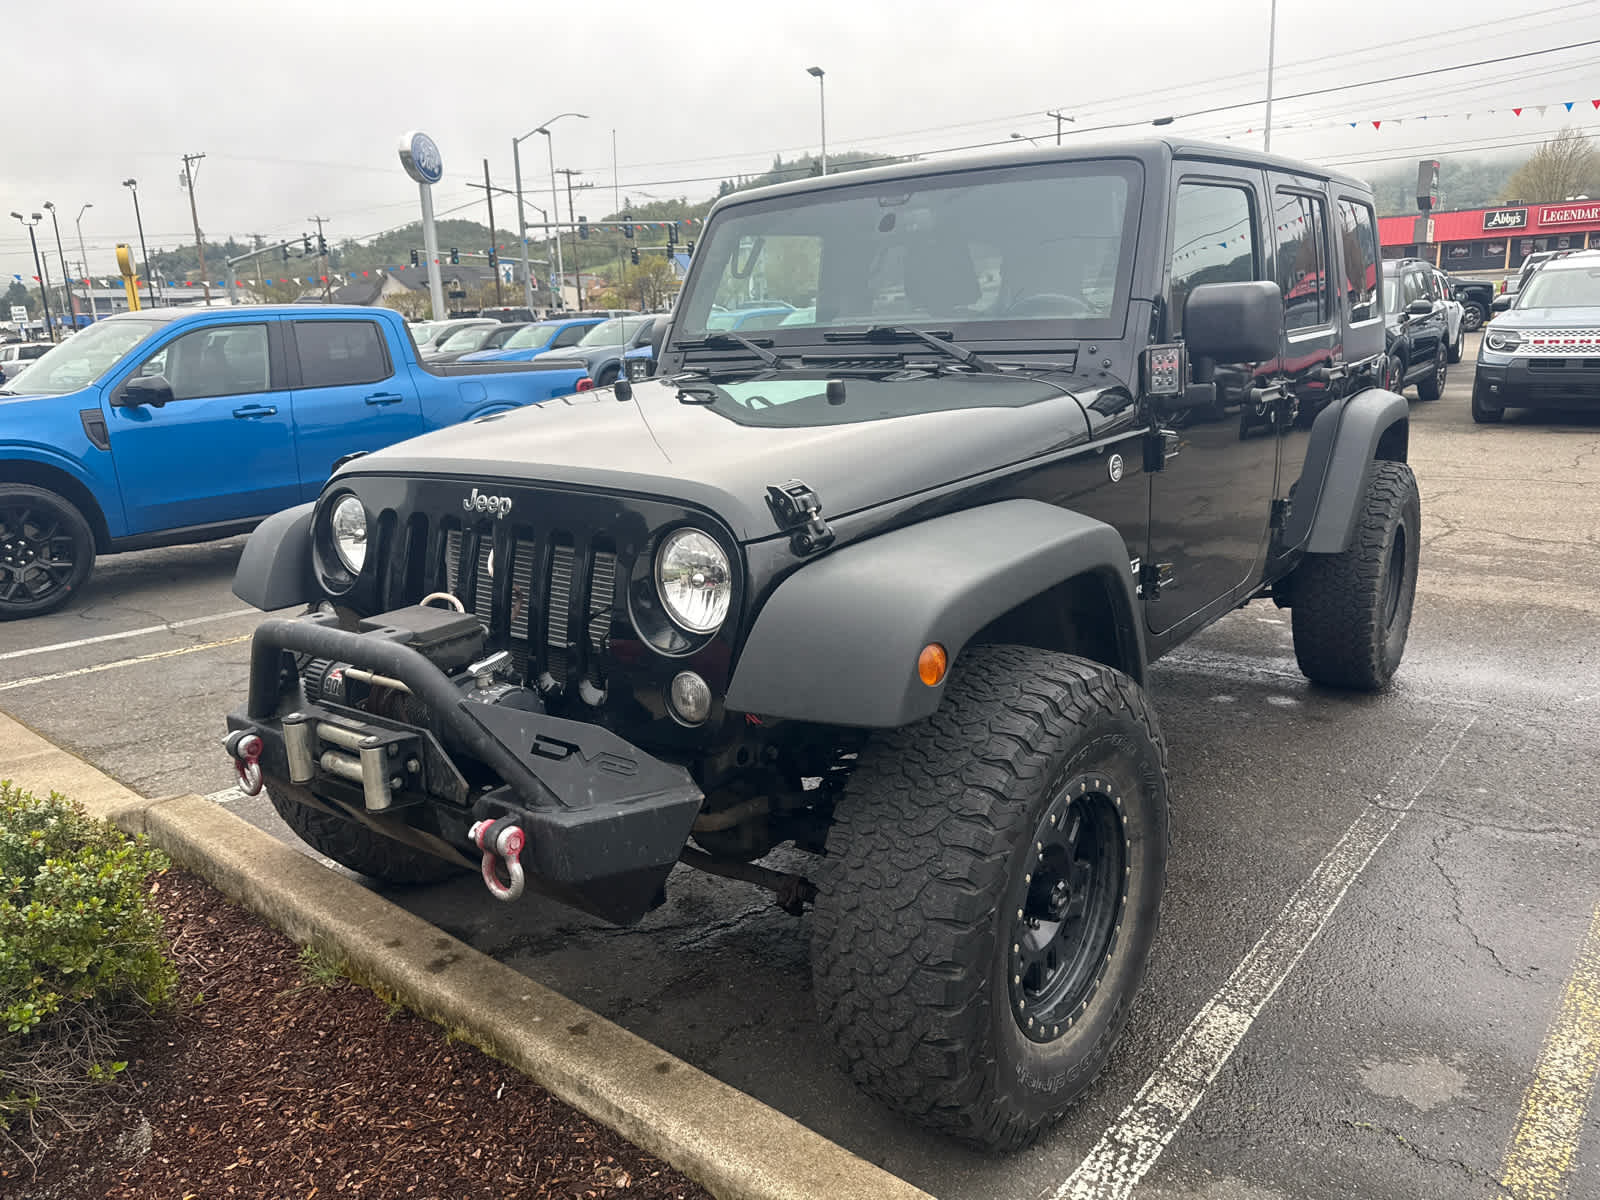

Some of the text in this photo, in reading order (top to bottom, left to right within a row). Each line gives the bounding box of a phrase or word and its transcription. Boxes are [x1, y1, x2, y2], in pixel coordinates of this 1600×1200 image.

[1487, 211, 1521, 227] Abby's
[1542, 206, 1600, 223] LEGENDAR
[463, 488, 512, 520] Jeep
[530, 734, 640, 777] DV8
